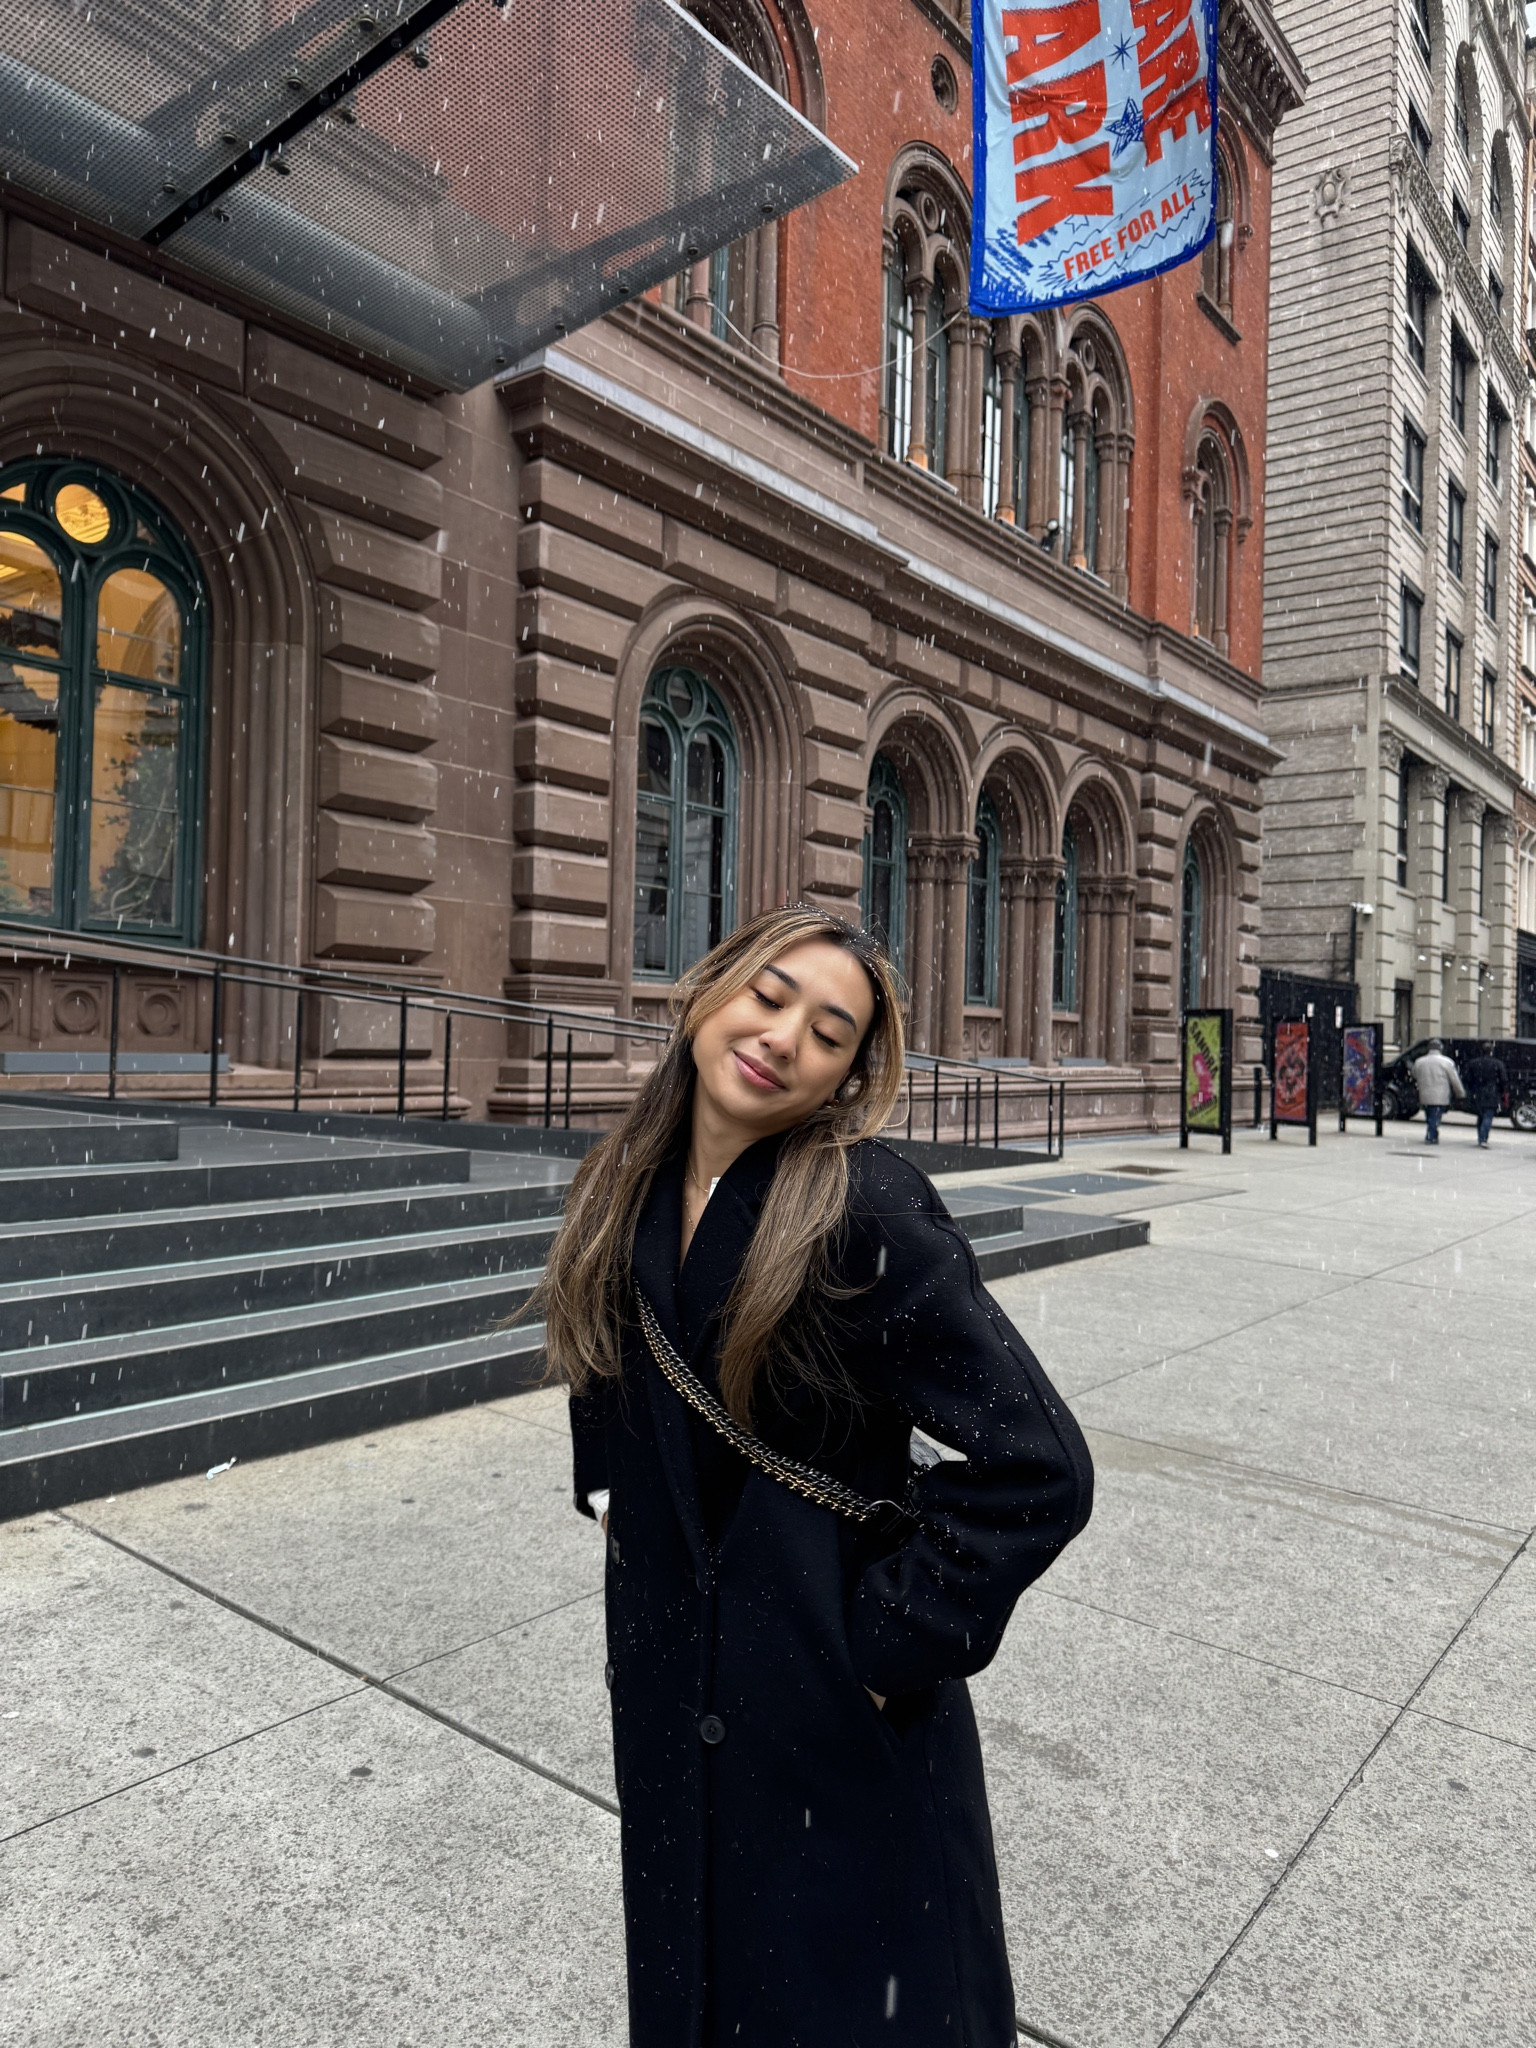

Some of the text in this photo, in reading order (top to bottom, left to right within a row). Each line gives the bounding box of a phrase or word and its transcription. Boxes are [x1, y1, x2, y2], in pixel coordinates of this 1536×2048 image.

[1002, 0, 1114, 246] ARK
[1129, 0, 1213, 167] ARE
[1064, 183, 1195, 281] FREE FOR ALL
[1189, 1021, 1218, 1080] SANDRA
